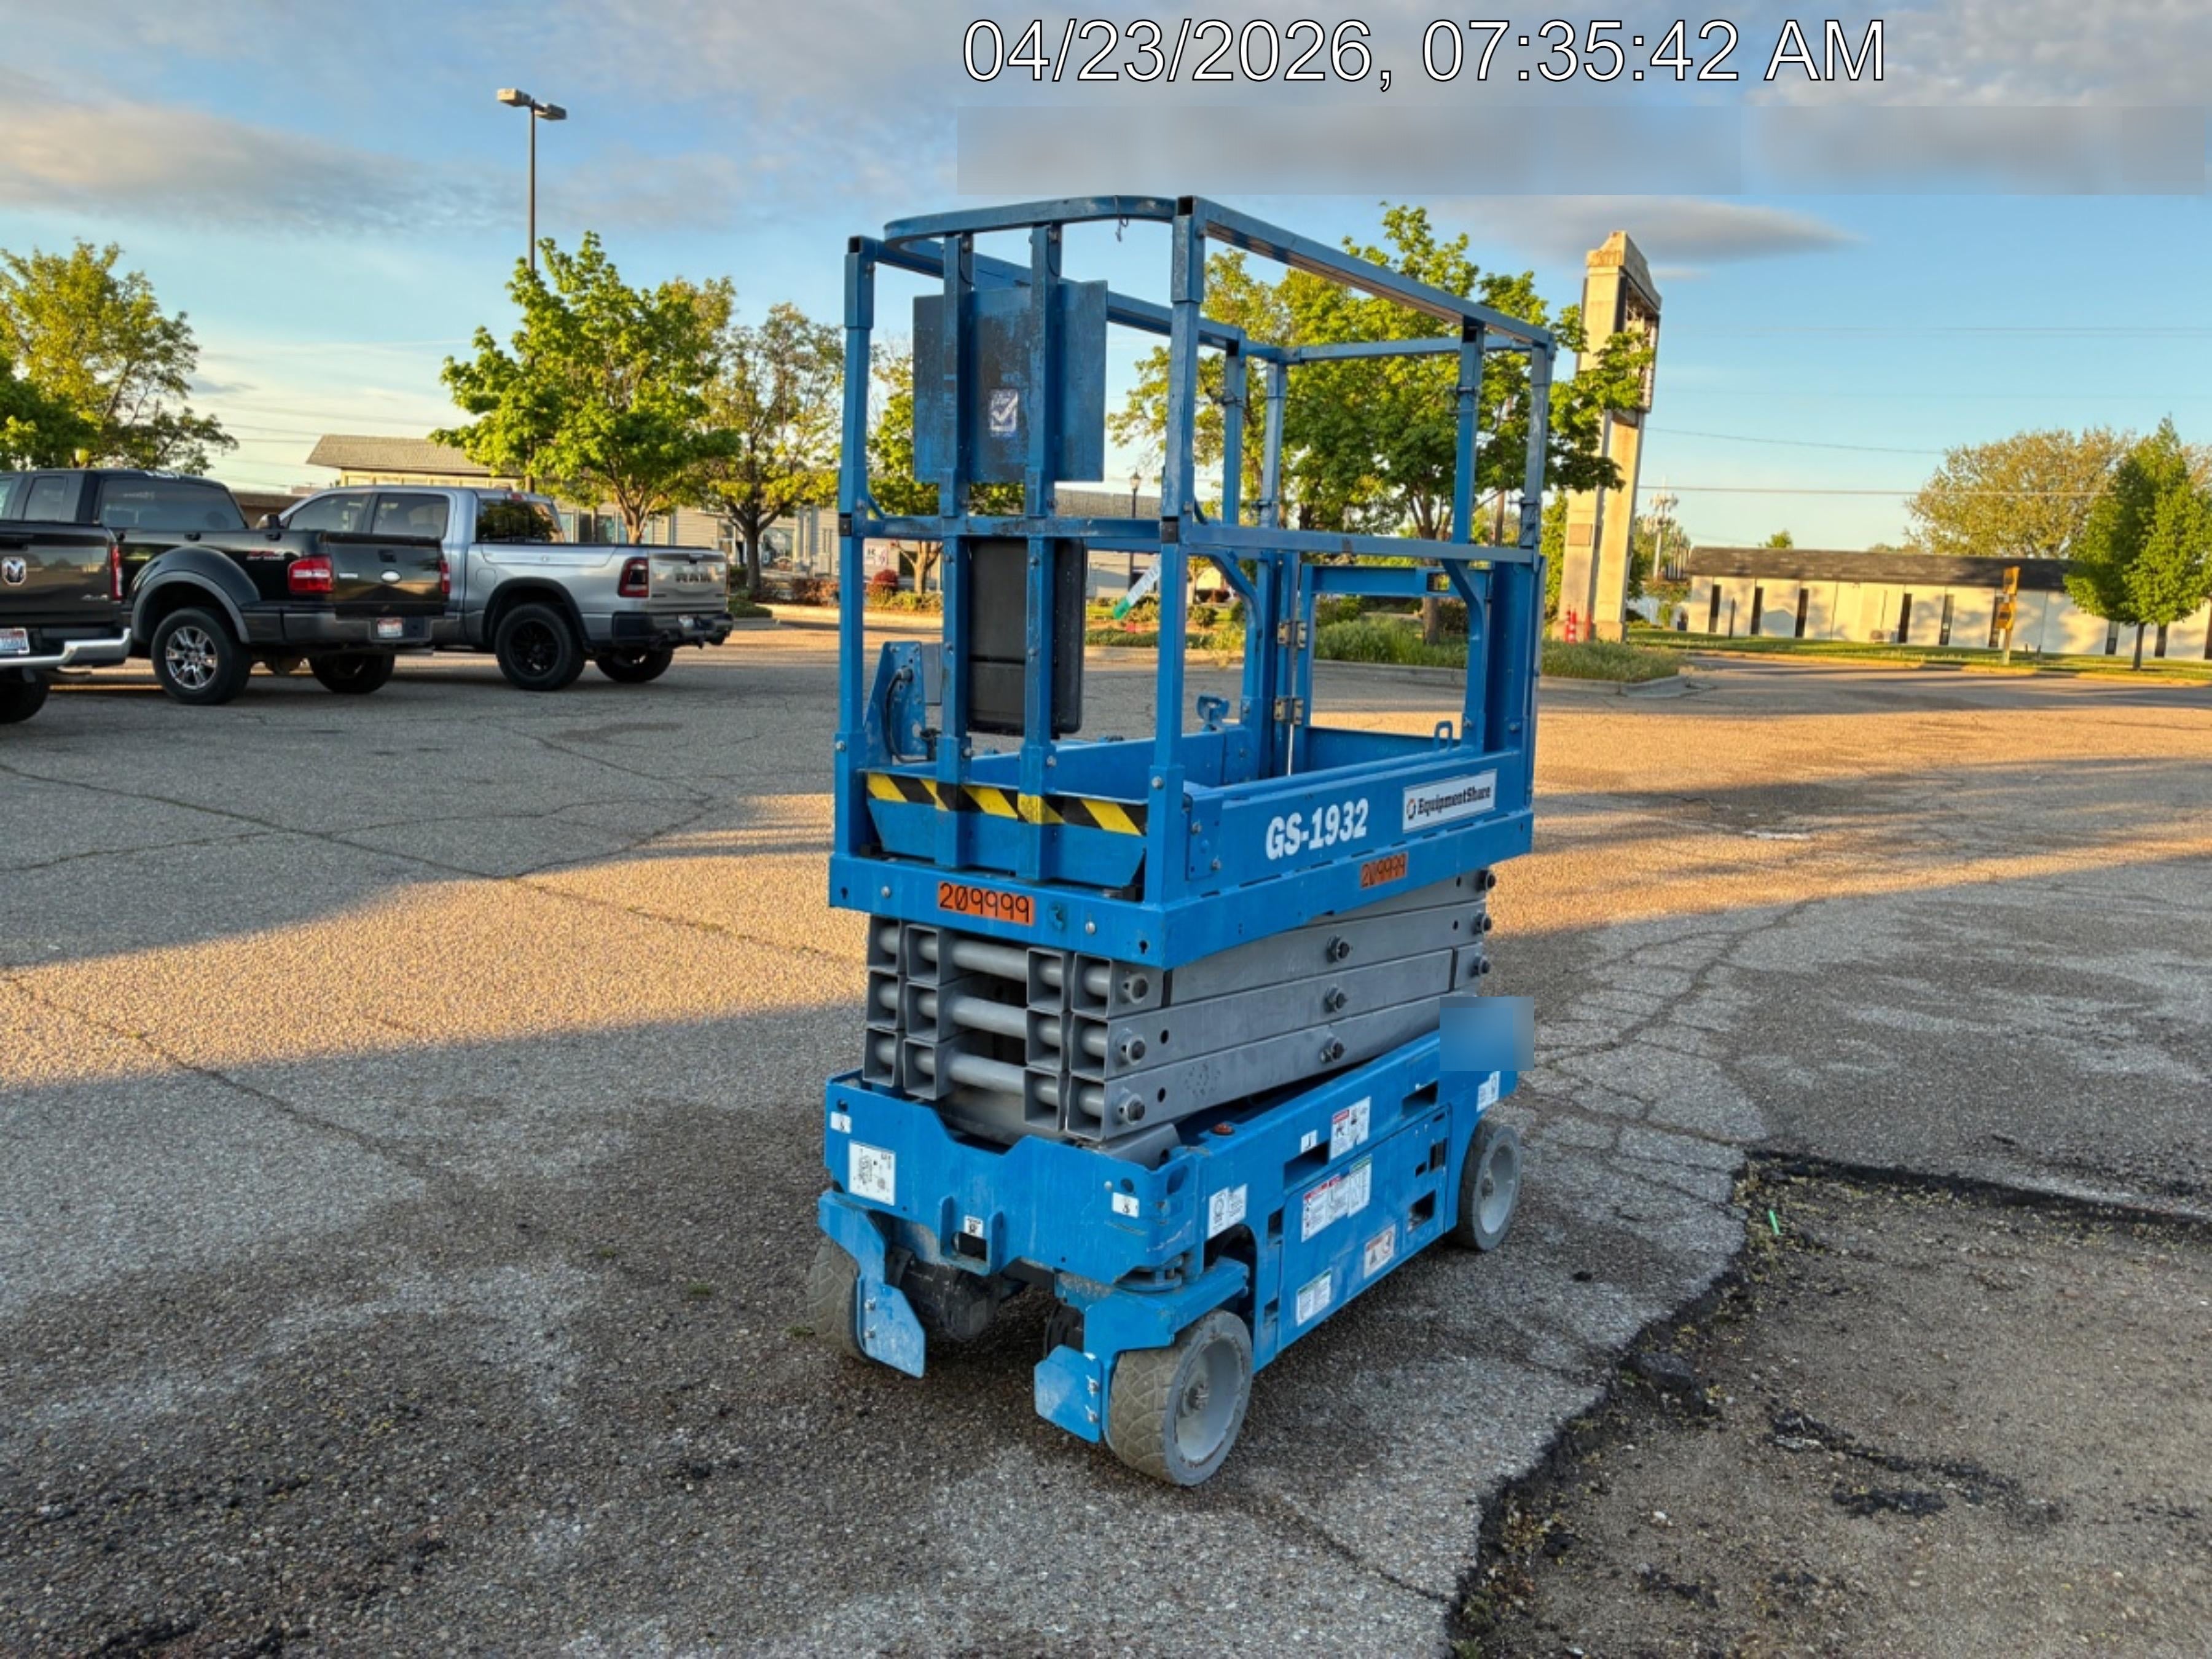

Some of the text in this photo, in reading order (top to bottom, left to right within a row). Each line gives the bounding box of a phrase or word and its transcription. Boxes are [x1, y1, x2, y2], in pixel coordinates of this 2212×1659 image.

[1418, 786, 1491, 817] EquipmentShare
[1266, 798, 1368, 860] GS-1932
[939, 882, 1030, 923] 209999
